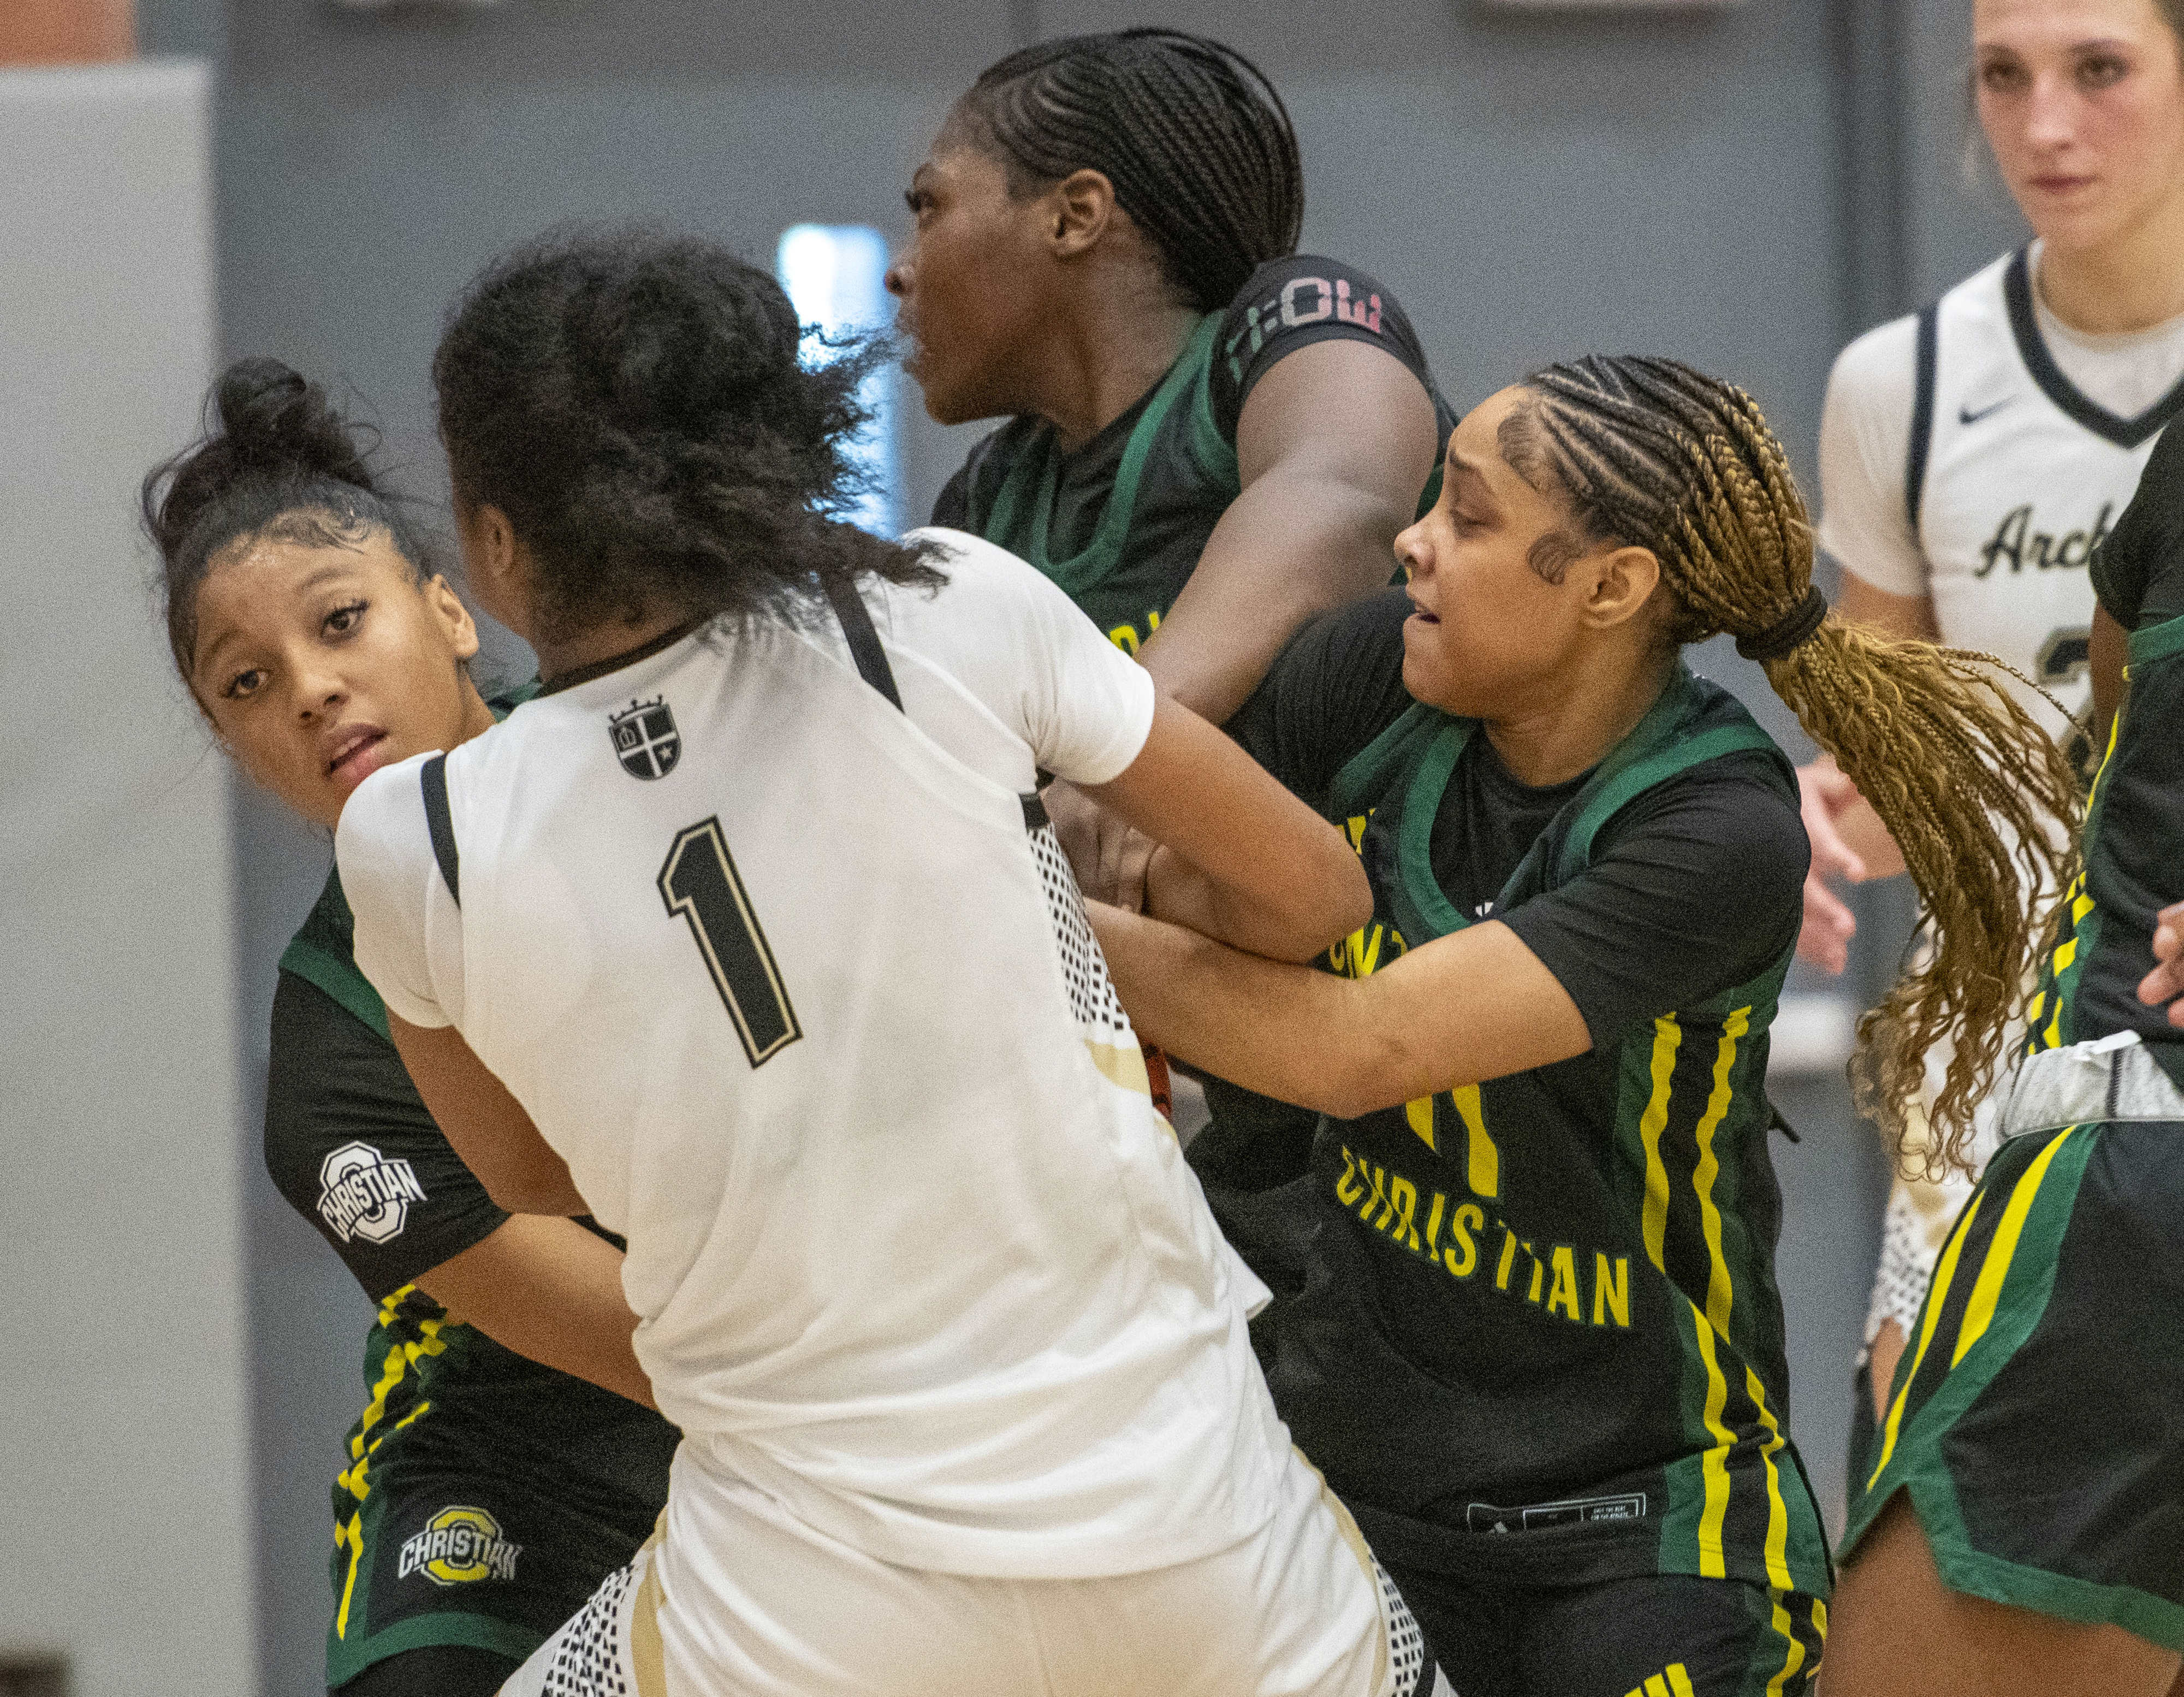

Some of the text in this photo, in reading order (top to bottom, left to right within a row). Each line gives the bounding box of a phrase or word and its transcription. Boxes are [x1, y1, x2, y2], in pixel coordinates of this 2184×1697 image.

[656, 814, 803, 1069] 1
[321, 1162, 429, 1244] CHRISTIAN
[1337, 1145, 1630, 1327] CHRISTIAN
[398, 1528, 523, 1580] CHRISTIAN
